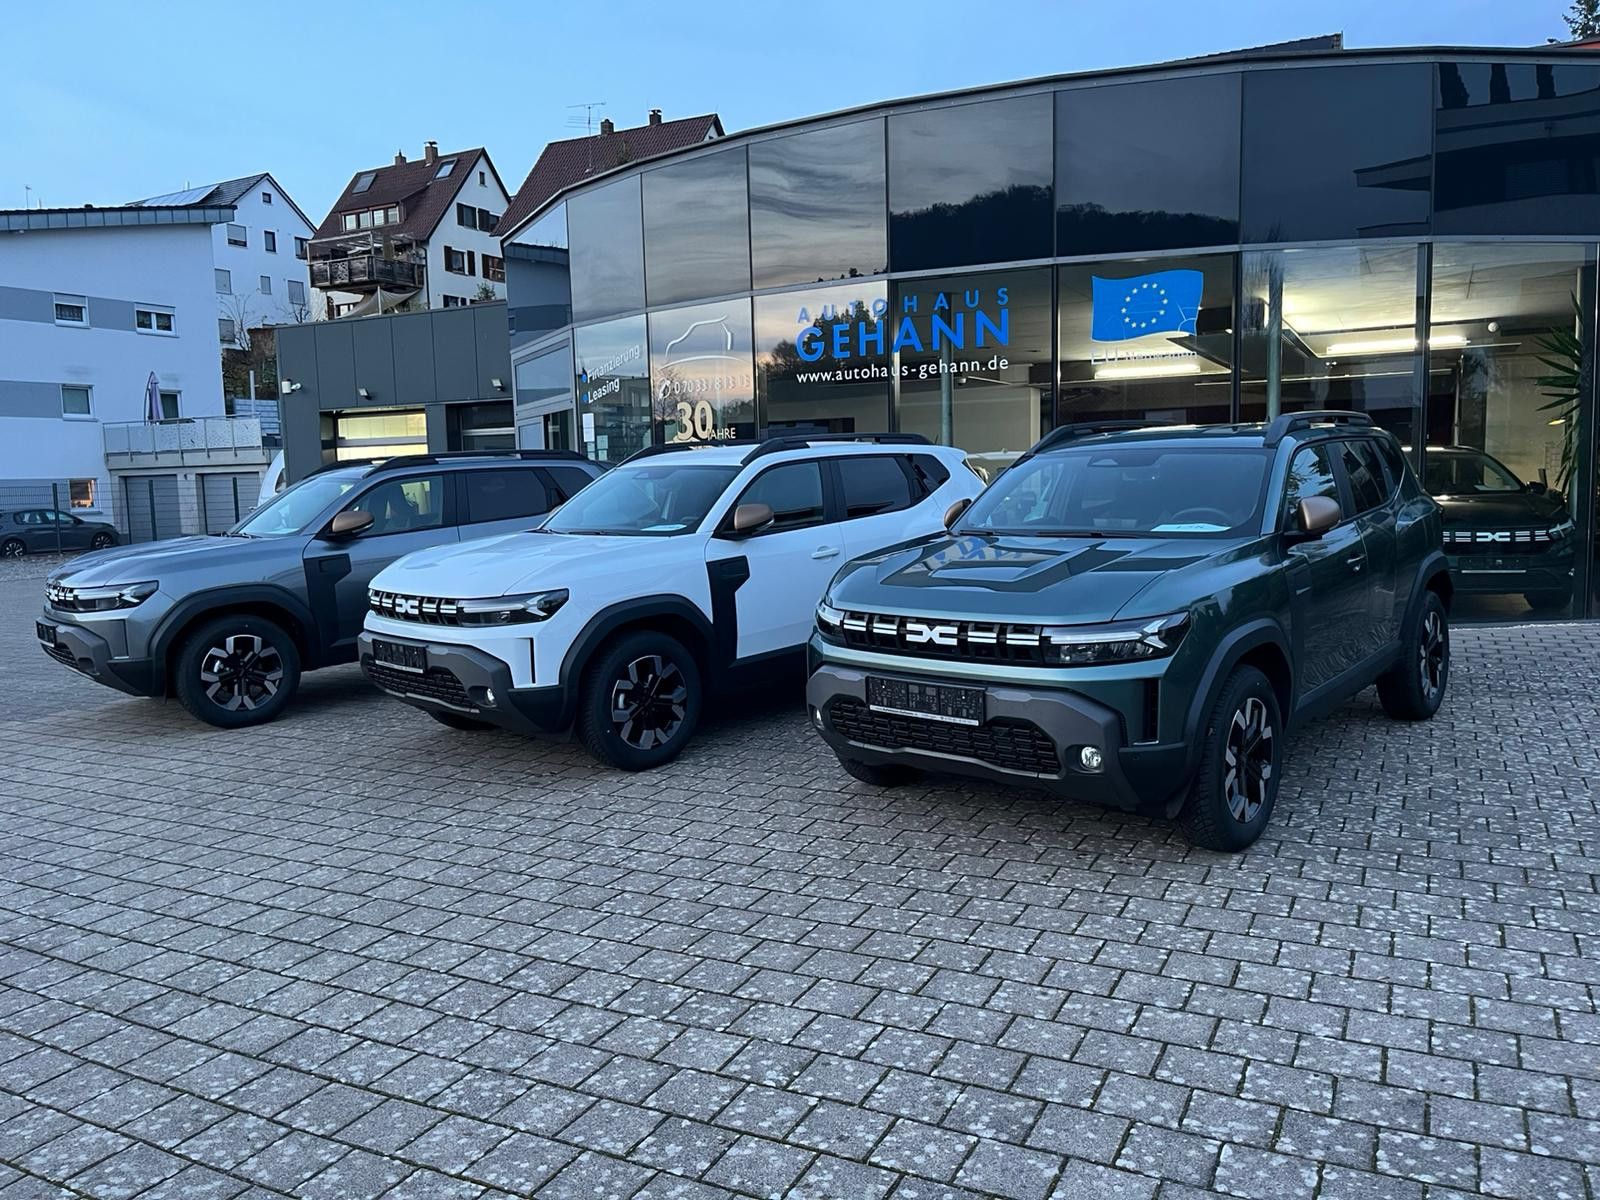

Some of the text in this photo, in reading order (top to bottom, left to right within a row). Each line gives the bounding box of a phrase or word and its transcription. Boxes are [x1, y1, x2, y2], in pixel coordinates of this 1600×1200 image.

[797, 287, 1009, 323] AUTOHAUS
[796, 308, 1009, 362] GEHANN
[587, 344, 640, 384] Finanzierung
[796, 355, 1009, 384] www.autohaus-gehann.de
[587, 378, 620, 404] Leasing
[676, 400, 714, 441] 30
